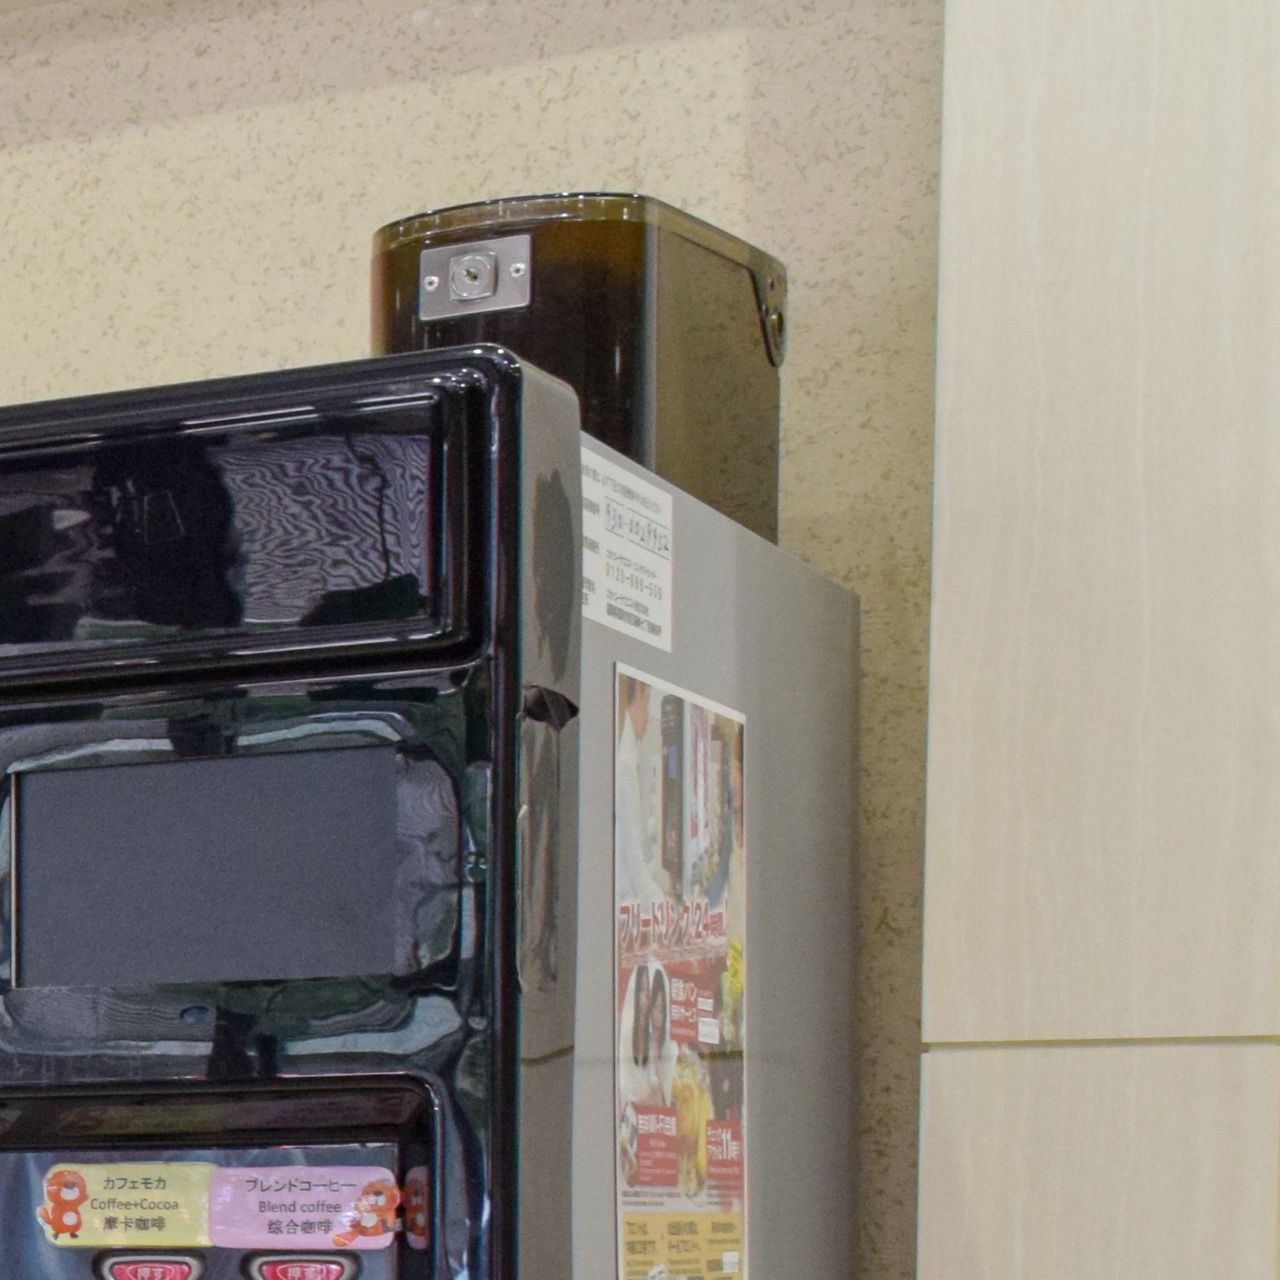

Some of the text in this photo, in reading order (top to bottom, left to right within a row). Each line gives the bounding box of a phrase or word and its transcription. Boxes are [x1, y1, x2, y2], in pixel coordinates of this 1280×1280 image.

[103, 1177, 167, 1190] カフェモカ
[245, 1178, 358, 1193] ブレンドコーヒー
[90, 1198, 179, 1210] Coffee+Cocoa
[258, 1200, 342, 1213] Blend coffee
[103, 1216, 167, 1232] 摩卡咖啡
[267, 1219, 333, 1235] 综合咖啡
